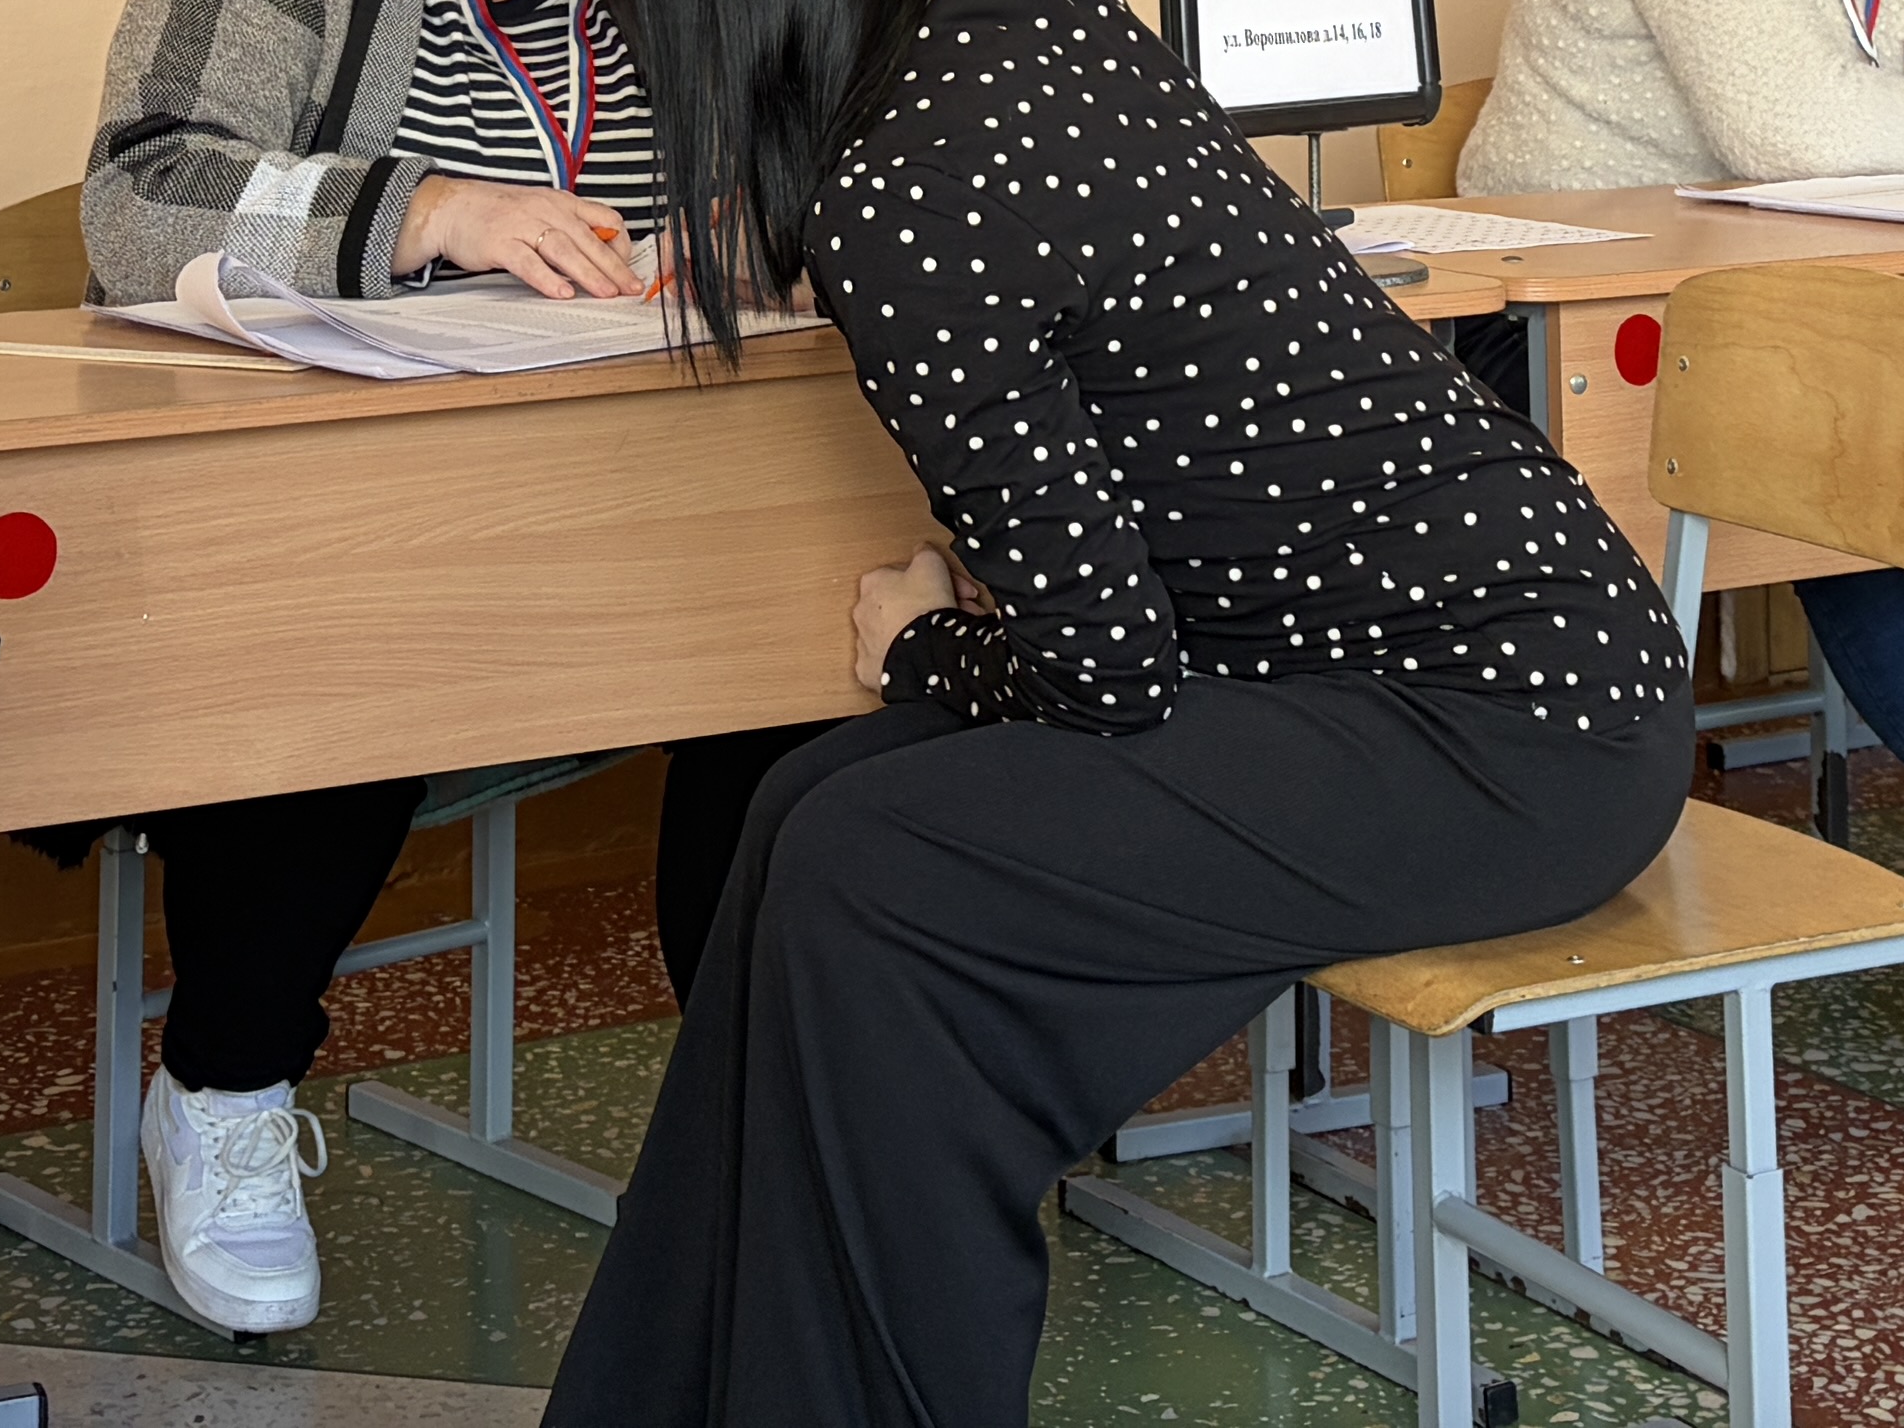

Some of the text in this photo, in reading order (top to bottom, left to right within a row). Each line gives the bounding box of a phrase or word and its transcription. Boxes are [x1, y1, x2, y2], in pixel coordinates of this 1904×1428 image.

[1244, 28, 1321, 51] Ворошилова
[1351, 22, 1368, 42] 16,
[1369, 21, 1382, 39] 18
